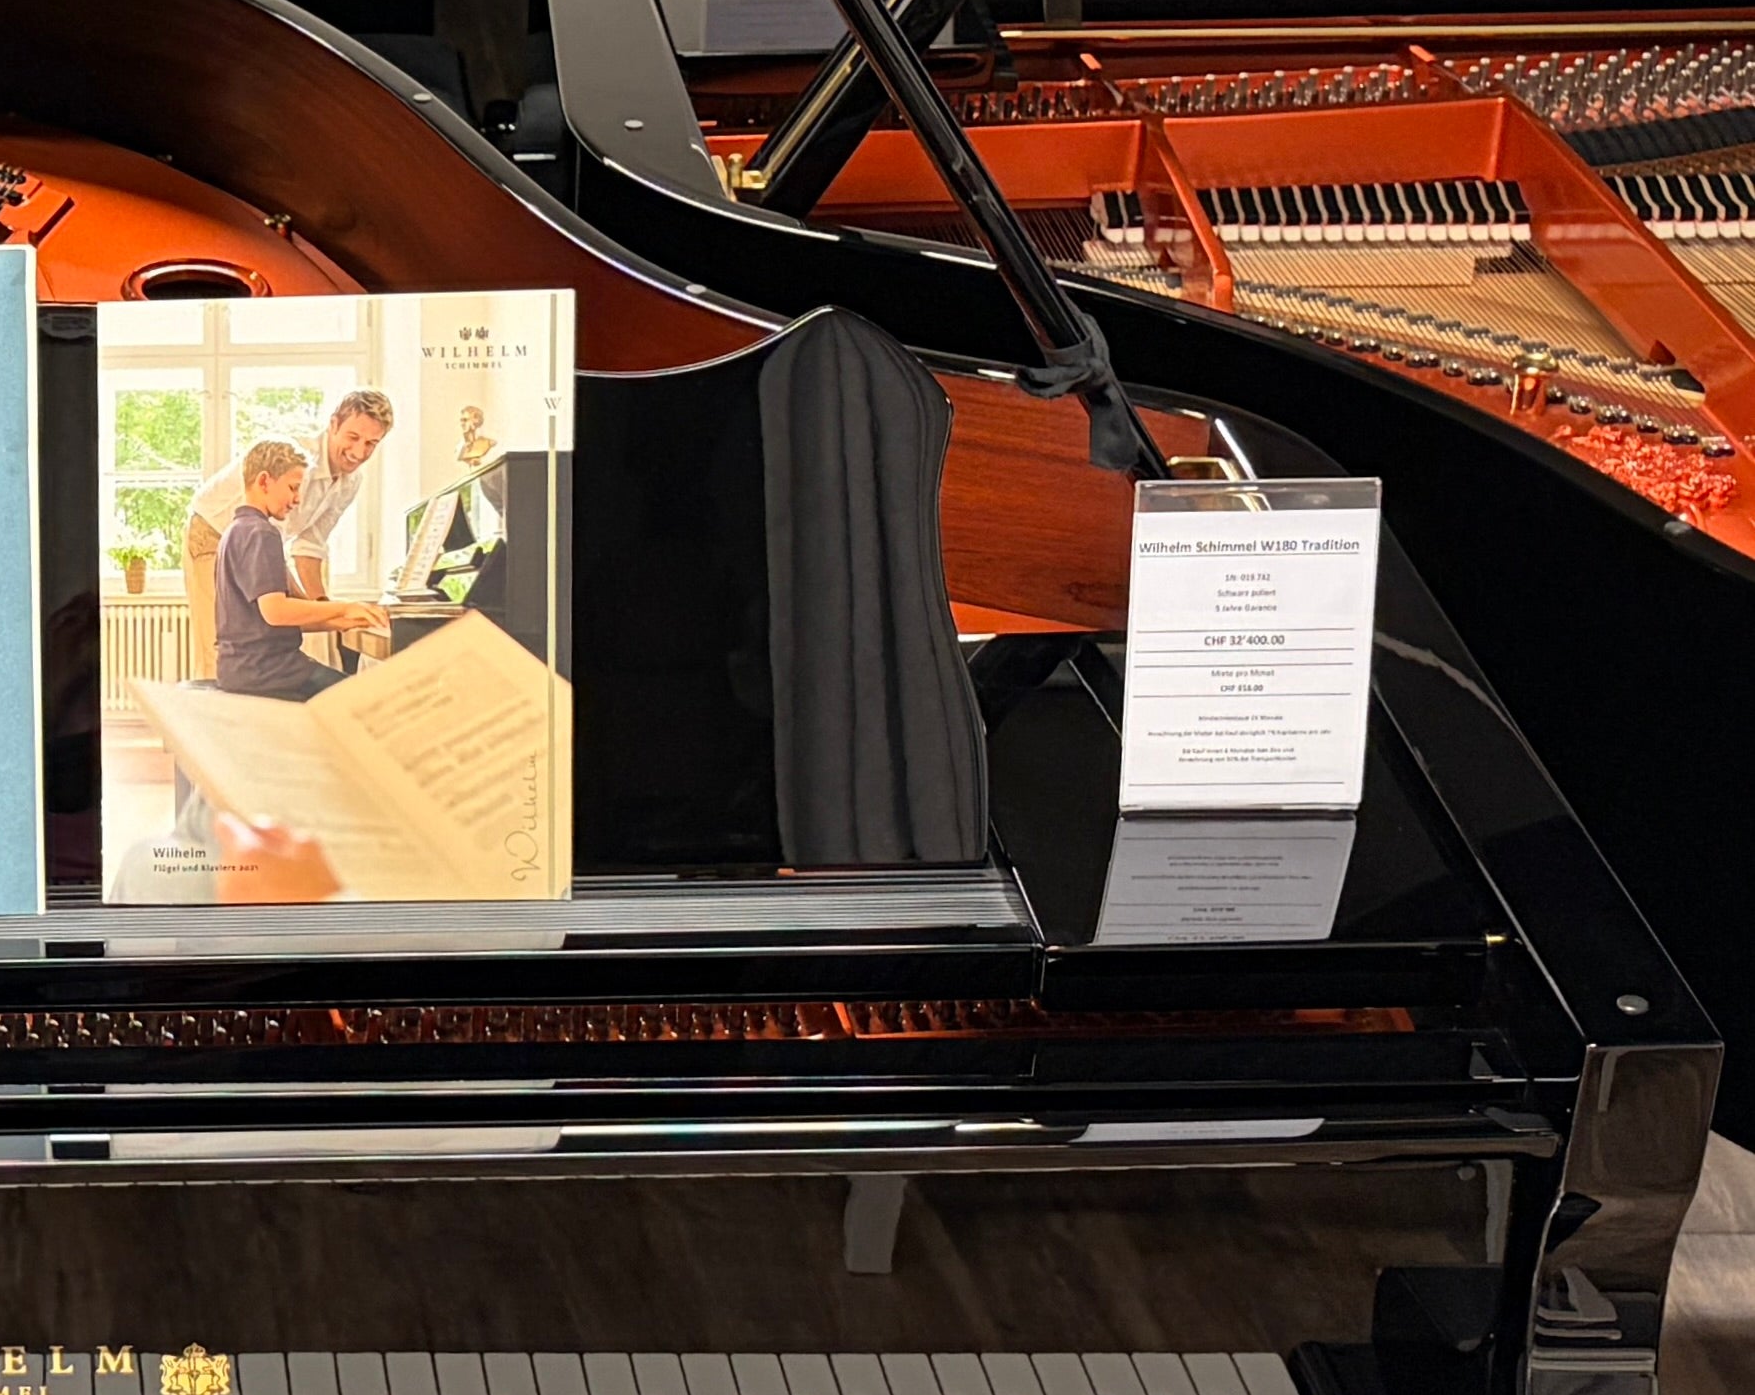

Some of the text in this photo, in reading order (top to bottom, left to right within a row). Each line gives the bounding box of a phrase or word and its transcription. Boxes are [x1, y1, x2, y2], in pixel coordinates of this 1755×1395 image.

[421, 345, 527, 359] WILHELM
[544, 396, 562, 410] W
[1139, 539, 1360, 554] Wilhelm Schimmel W180 Tradition
[1204, 635, 1227, 647] CHF
[153, 847, 206, 859] Wilhelm
